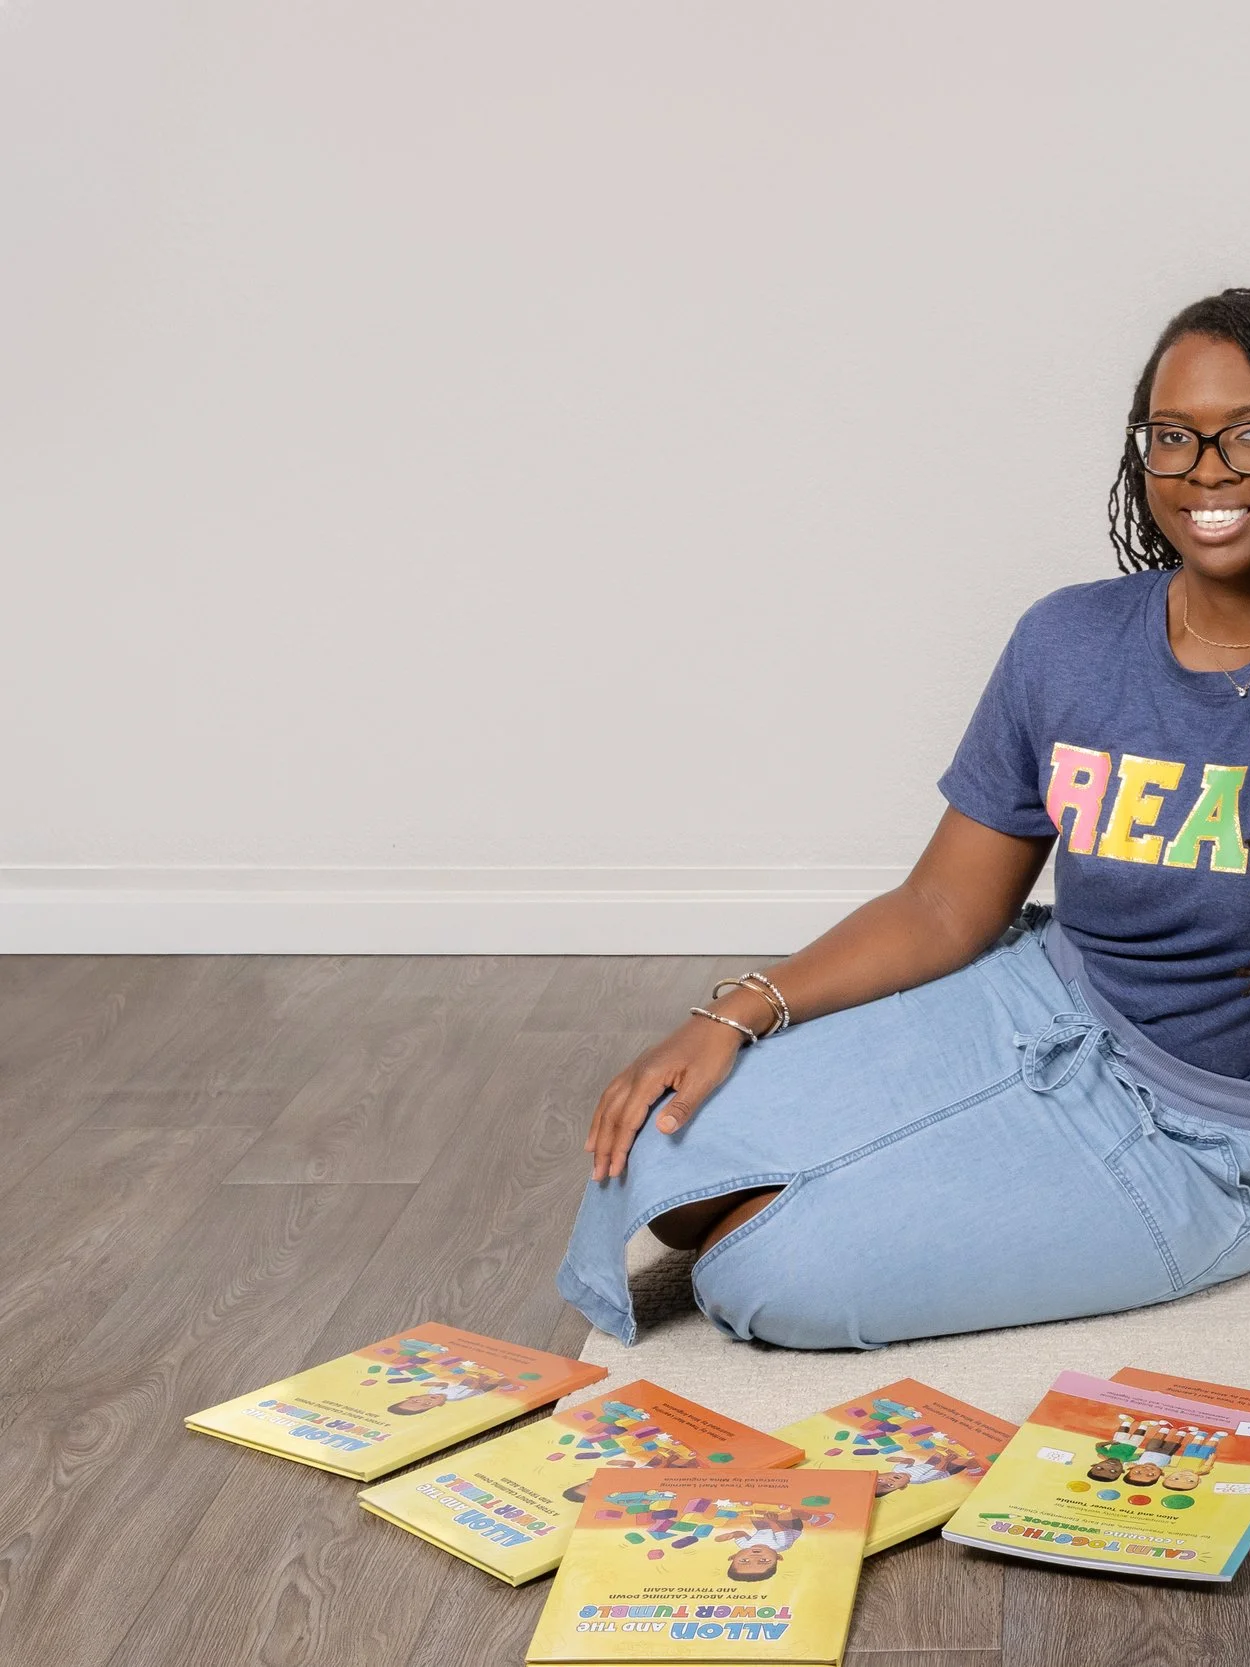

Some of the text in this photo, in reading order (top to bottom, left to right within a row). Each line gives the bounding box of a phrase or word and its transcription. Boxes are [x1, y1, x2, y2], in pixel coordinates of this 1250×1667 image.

[257, 1399, 392, 1442] TOWER TUMBLE
[288, 1424, 374, 1452] ALLON
[434, 1473, 559, 1537] TOWER TUMBLE
[1008, 1505, 1038, 1514] Children
[1055, 1497, 1087, 1507] Tumble
[1090, 1504, 1116, 1512] Tower
[1022, 1515, 1100, 1535] WORKBOOK
[1040, 1511, 1080, 1522] Elementary
[452, 1508, 534, 1549] ALLON
[1103, 1530, 1172, 1545] COLORING
[990, 1520, 1197, 1561] CALM TOGETHER
[579, 1605, 792, 1619] TOWER TUMBLE
[576, 1622, 790, 1641] ALLON AND THE
